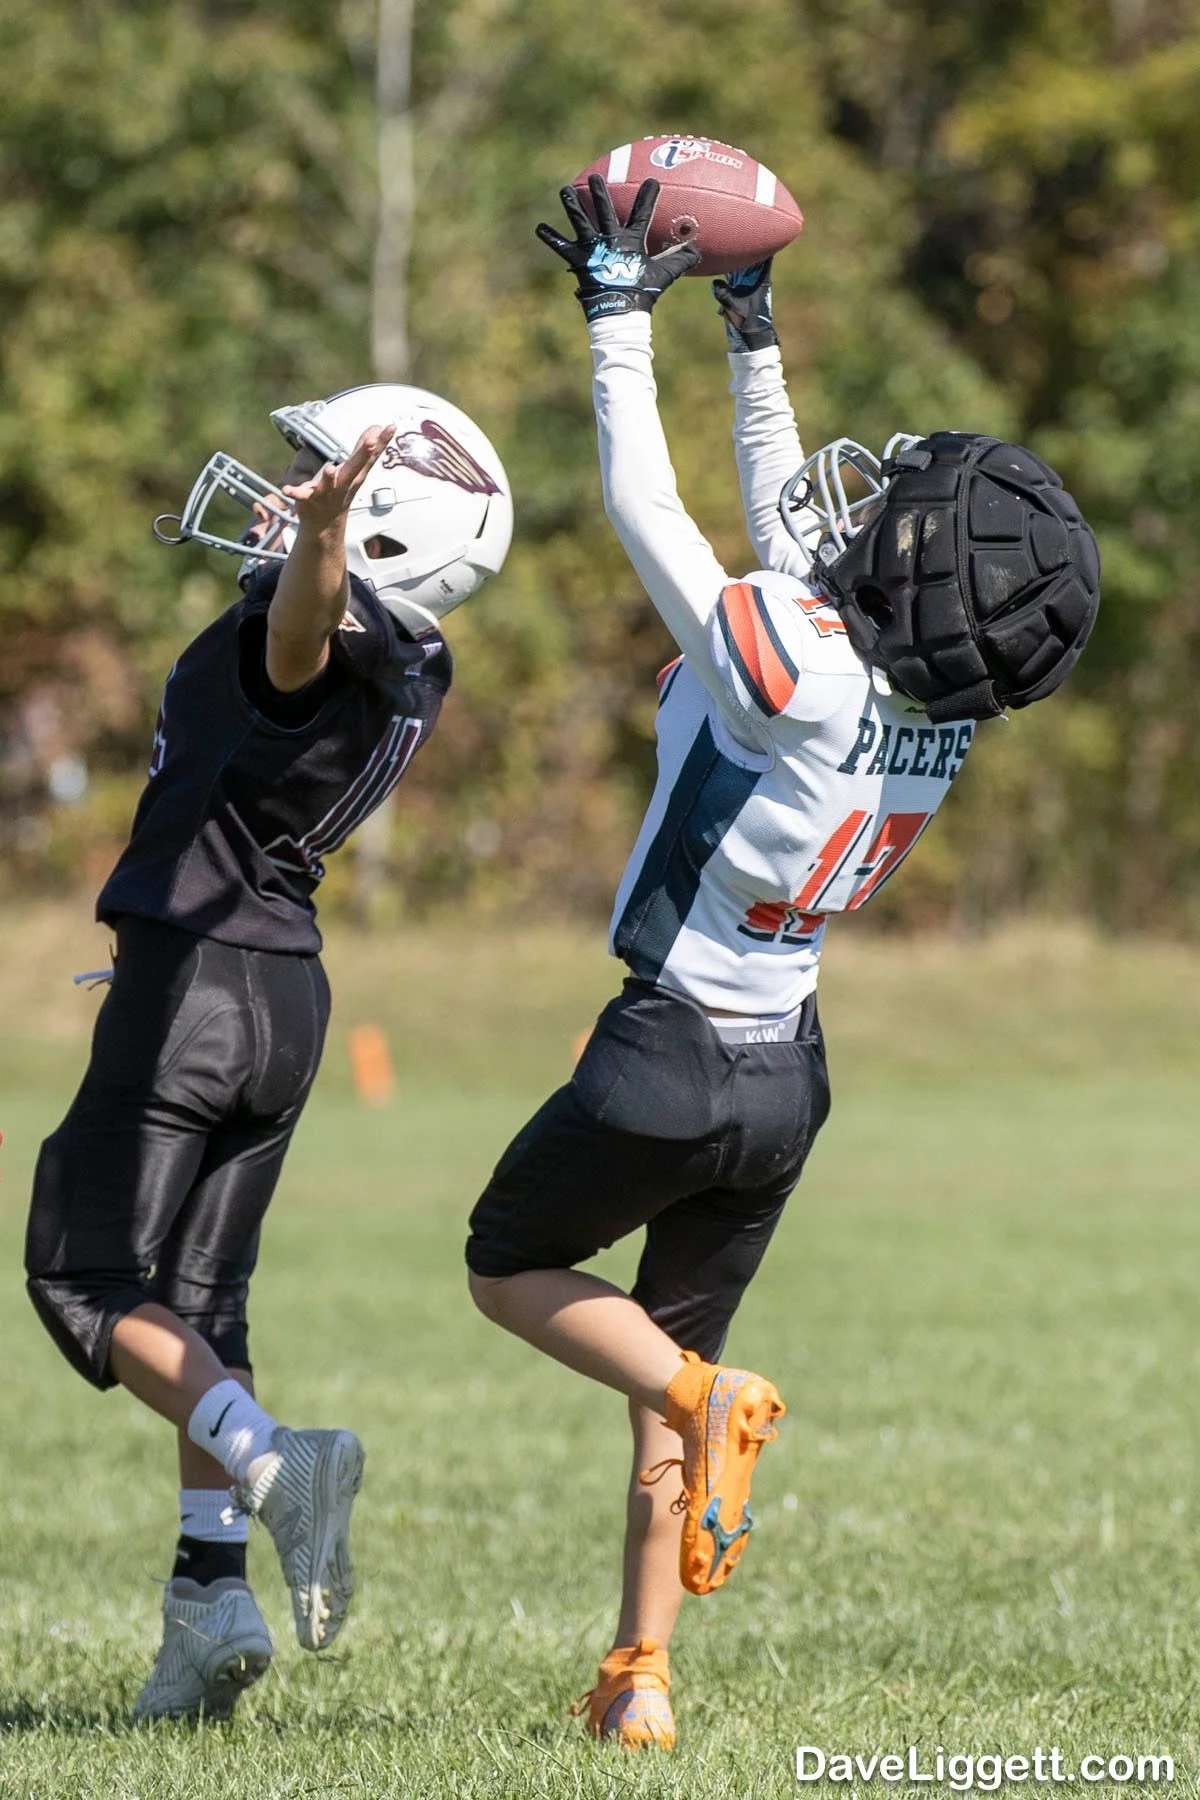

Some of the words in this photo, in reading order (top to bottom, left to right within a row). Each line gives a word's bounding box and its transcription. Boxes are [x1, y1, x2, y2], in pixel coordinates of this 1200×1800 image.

[600, 299, 626, 311] World
[837, 717, 972, 781] PACERS
[737, 809, 934, 945] 17
